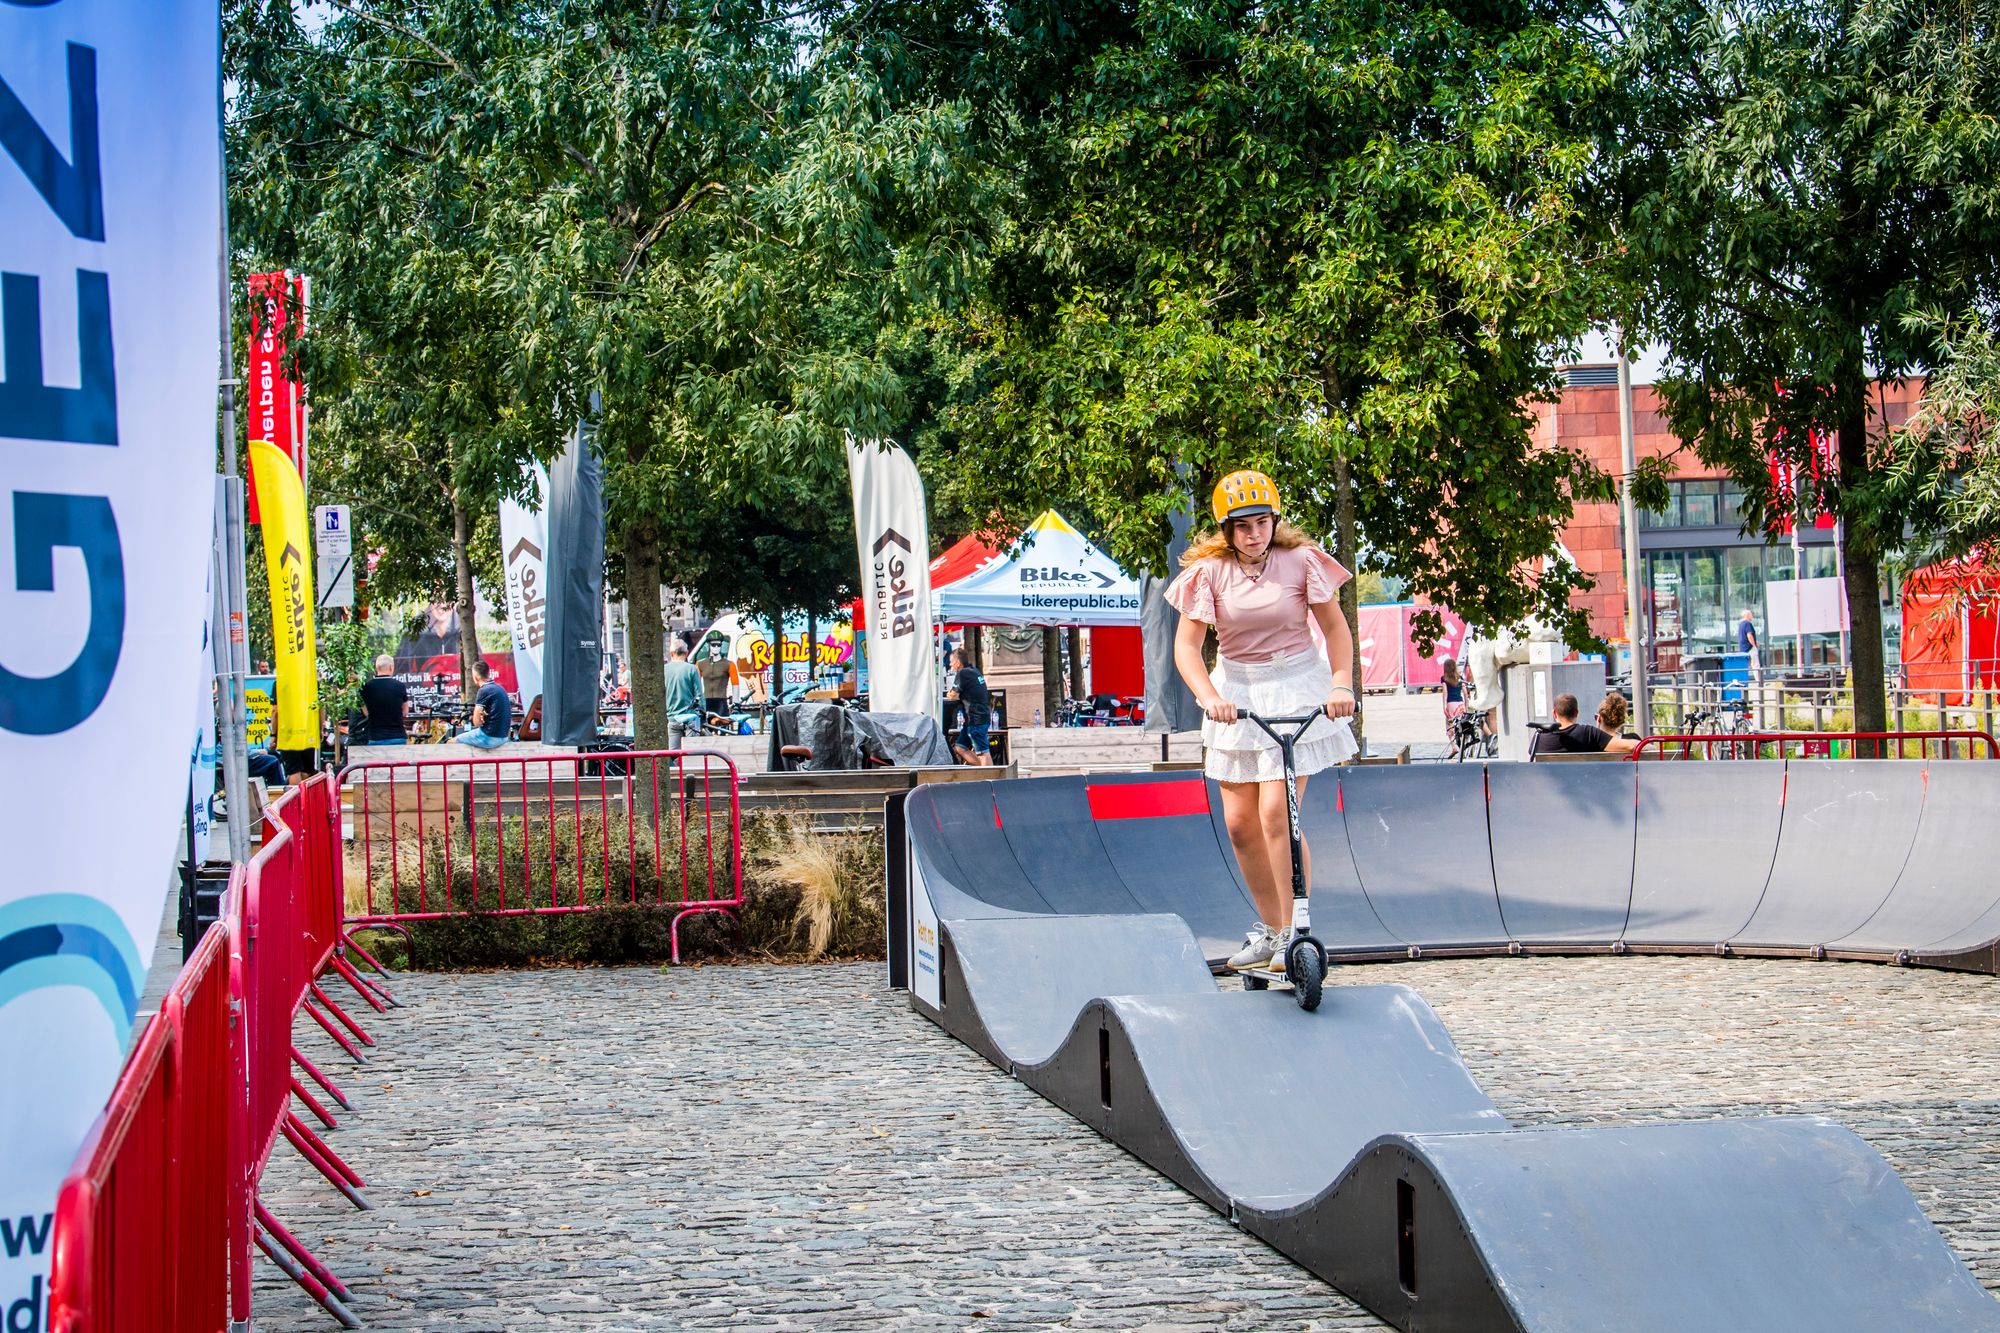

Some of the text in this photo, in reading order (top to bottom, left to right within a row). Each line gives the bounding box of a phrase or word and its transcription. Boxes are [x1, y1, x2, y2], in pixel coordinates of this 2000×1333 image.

[0, 0, 126, 736] GEZ
[1020, 567, 1092, 582] Bike
[1021, 594, 1140, 610] bikerepublic.be
[407, 673, 422, 682] ben
[785, 670, 810, 683] Cre
[246, 695, 270, 704] hake
[246, 706, 270, 714] rière
